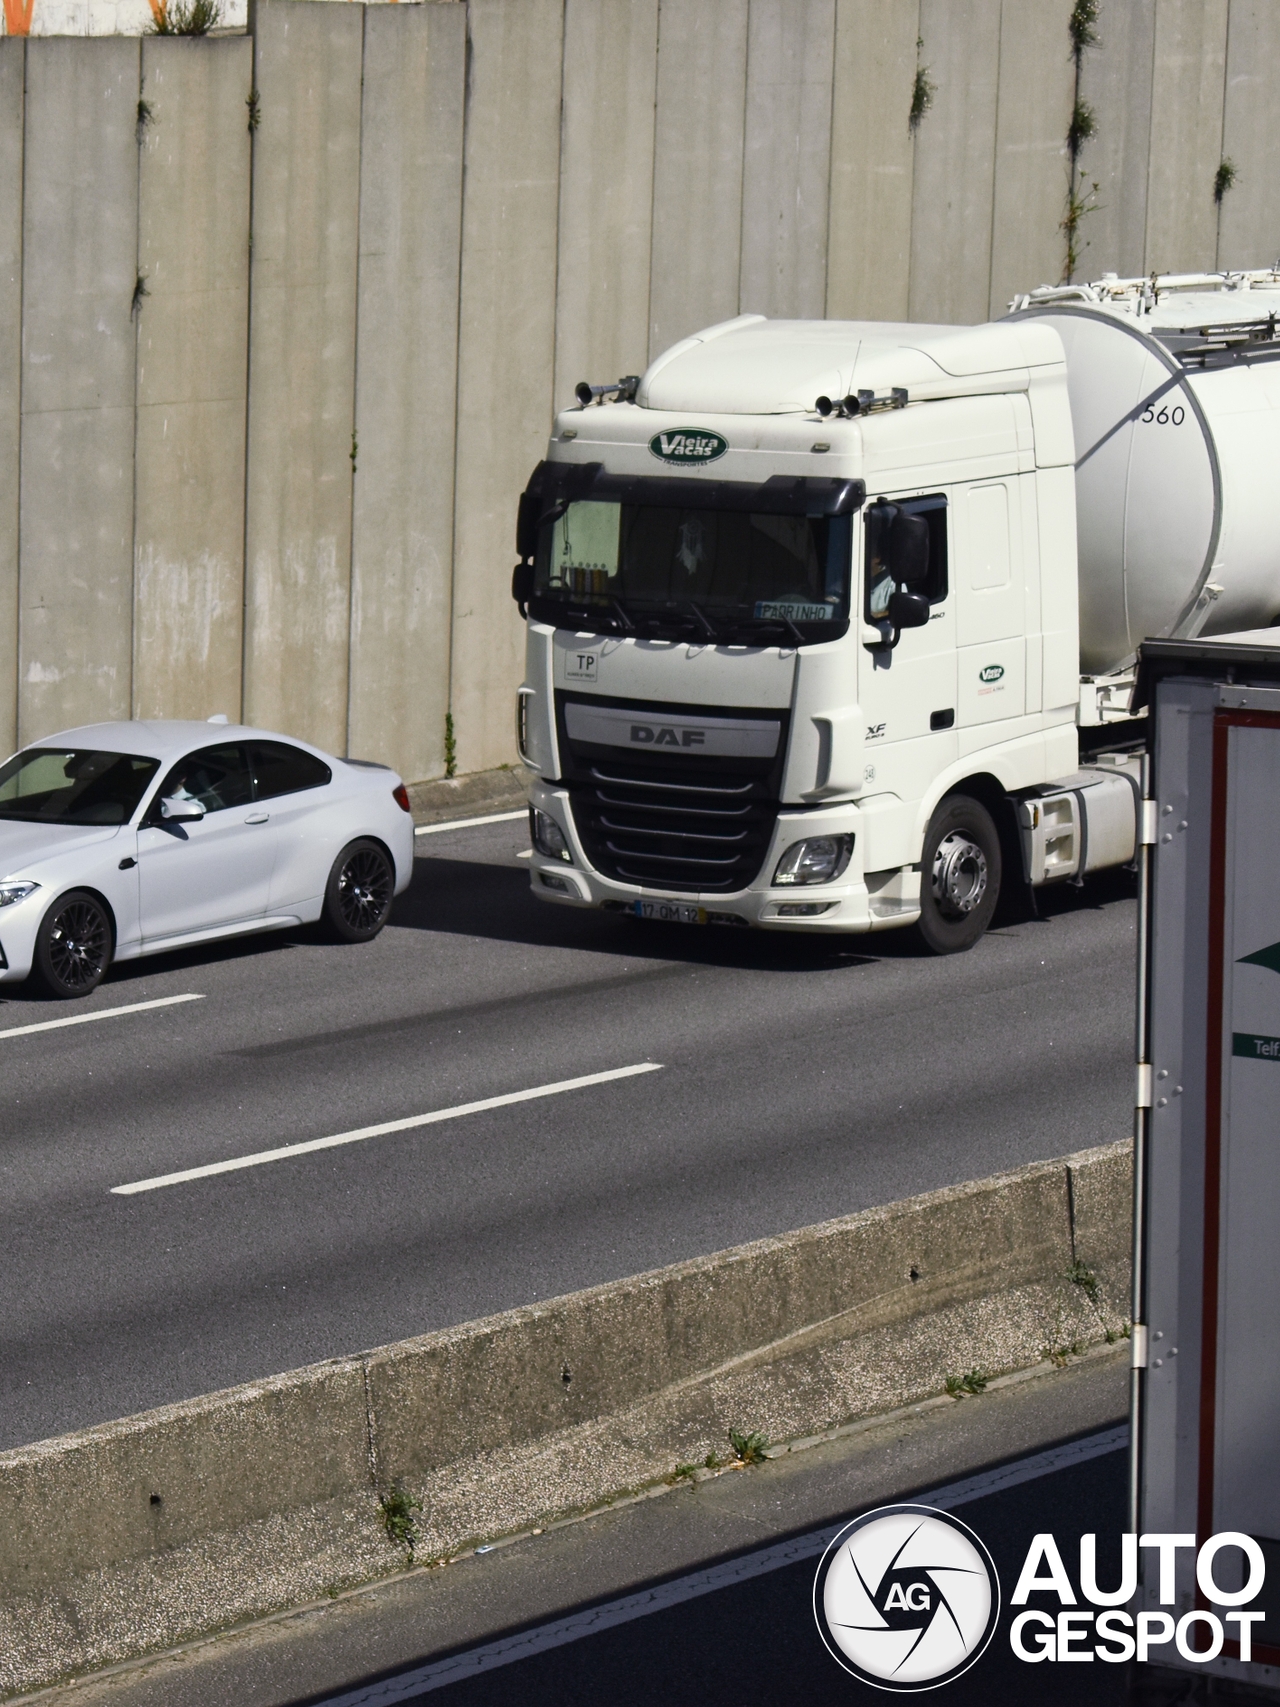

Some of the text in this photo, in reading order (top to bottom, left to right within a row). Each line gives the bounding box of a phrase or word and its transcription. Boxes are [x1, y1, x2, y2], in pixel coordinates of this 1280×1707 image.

[1142, 403, 1185, 426] 560
[660, 434, 718, 452] Vieira
[663, 459, 708, 467] TRANSPORTES
[762, 604, 826, 620] PADRINHO
[576, 654, 595, 670] TP
[630, 725, 705, 747] DAF
[866, 723, 887, 736] XF
